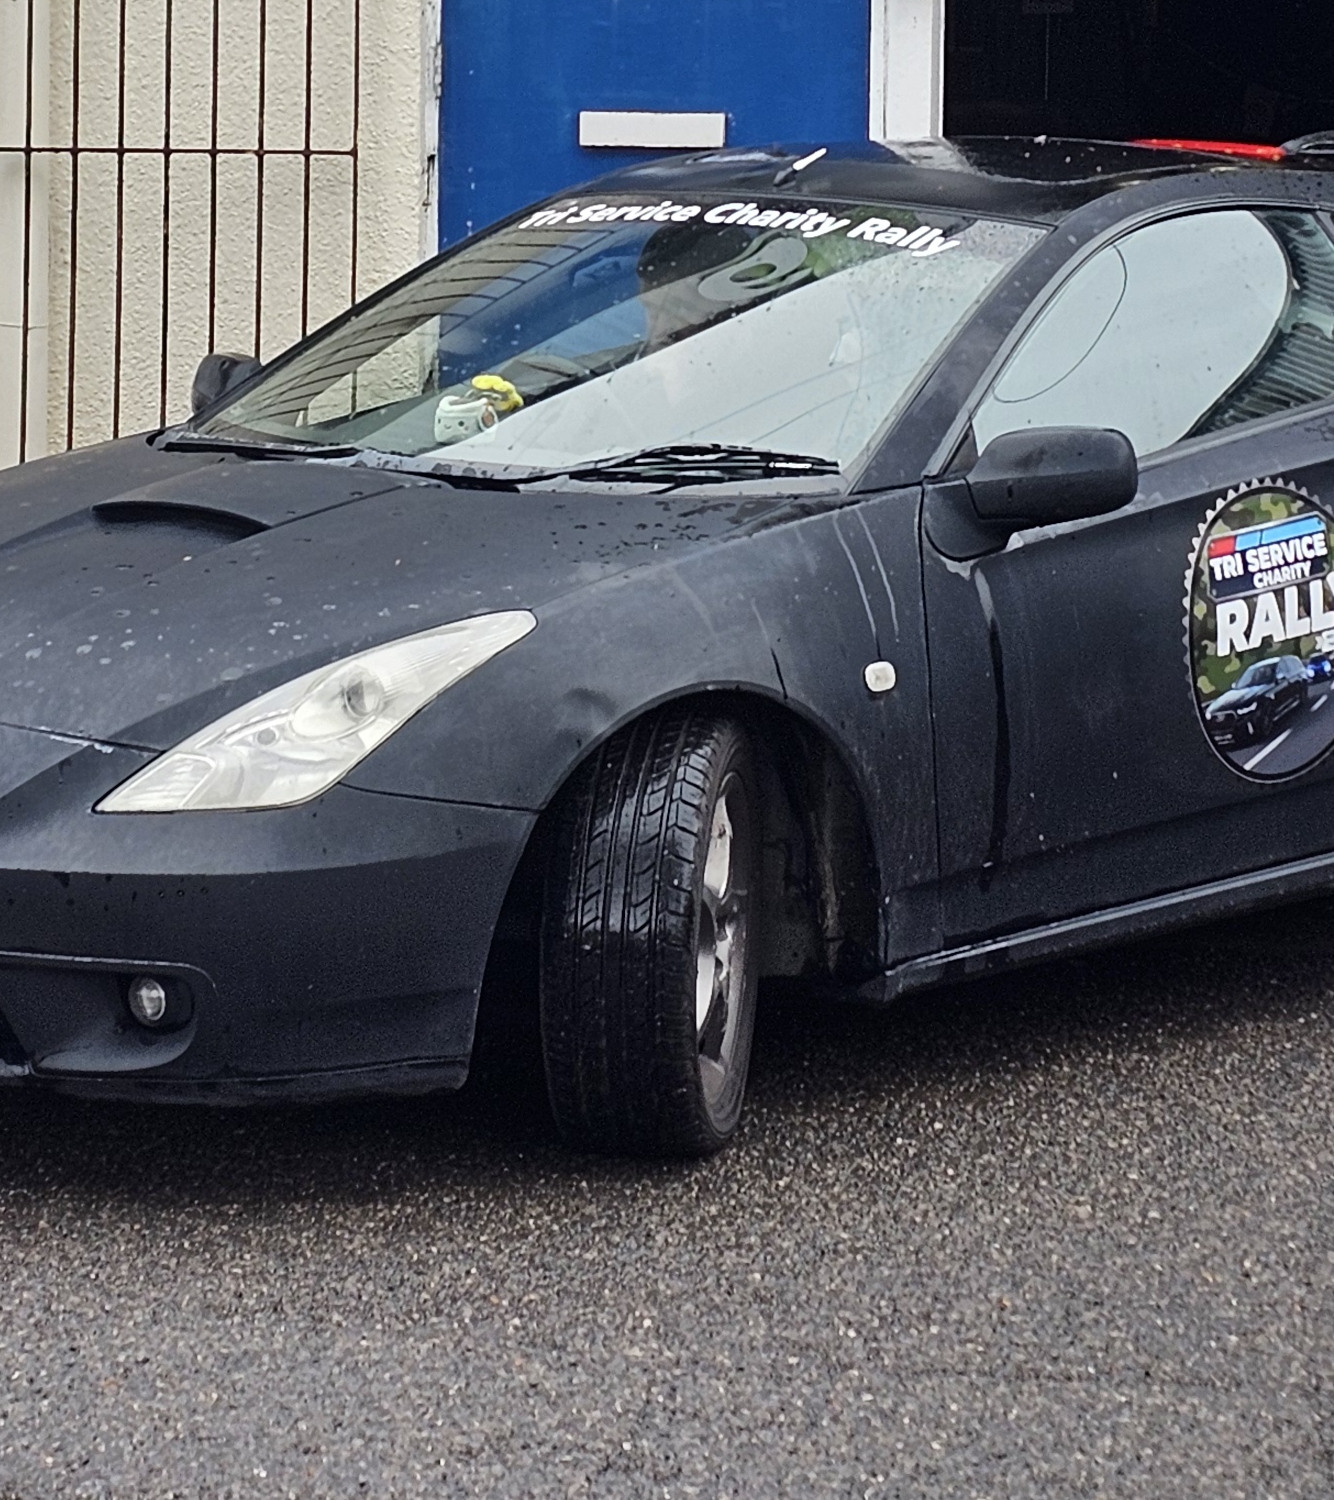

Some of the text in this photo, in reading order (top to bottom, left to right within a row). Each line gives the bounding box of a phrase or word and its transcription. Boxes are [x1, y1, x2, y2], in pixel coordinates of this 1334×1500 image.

[566, 200, 702, 224] Service
[703, 201, 851, 239] Charity
[846, 216, 962, 258] Rally
[1209, 533, 1329, 582] TRI SERVICE
[1253, 561, 1312, 589] CHARITY
